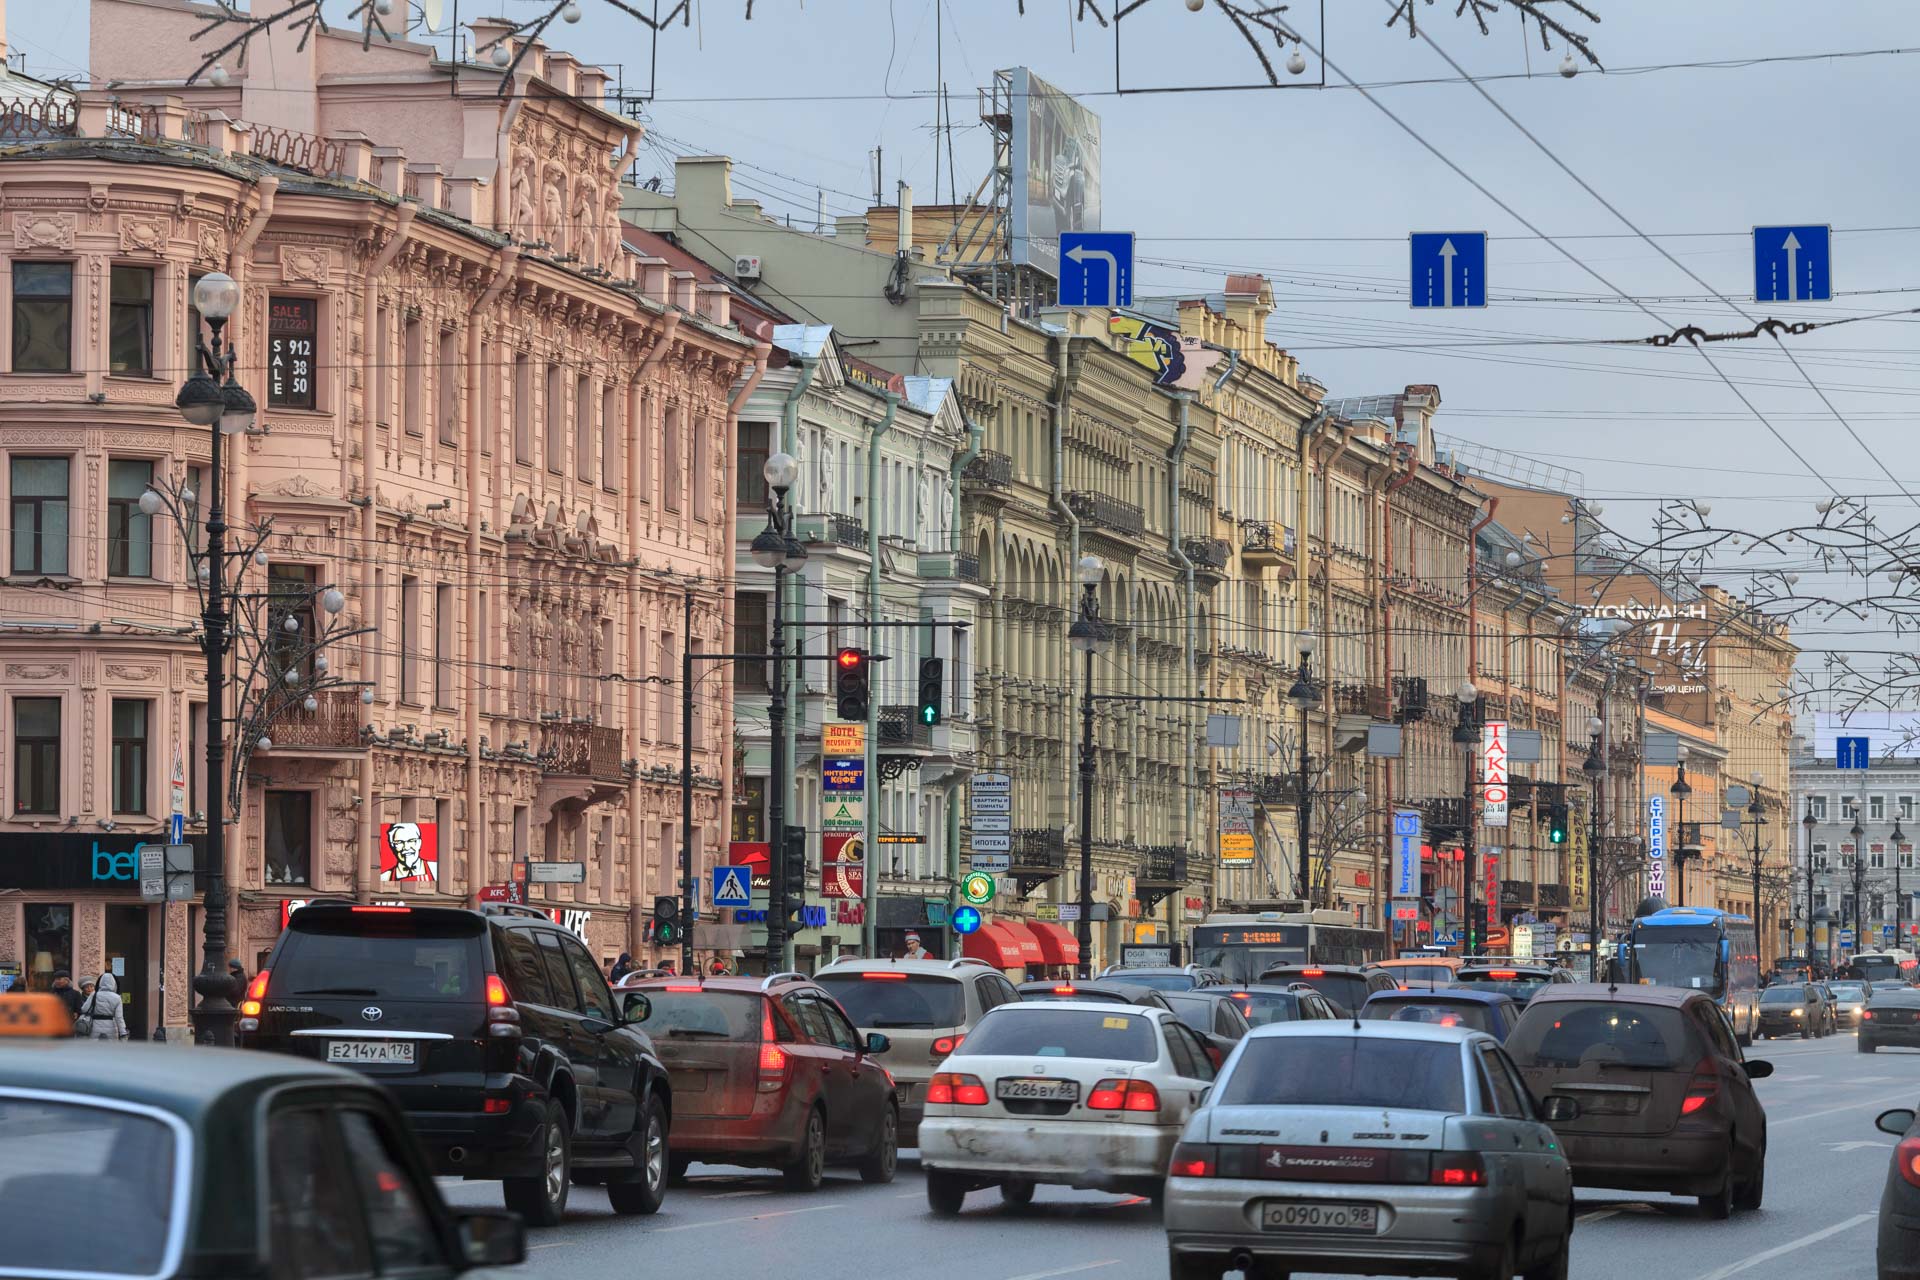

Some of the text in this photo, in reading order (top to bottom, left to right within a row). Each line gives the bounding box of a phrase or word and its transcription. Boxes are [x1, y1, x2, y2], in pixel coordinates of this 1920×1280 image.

[273, 306, 301, 317] SALE
[289, 339, 310, 355] 912
[273, 340, 283, 395] SALE
[293, 360, 307, 375] 38
[293, 378, 307, 393] 50
[831, 727, 856, 737] HOTEL
[1652, 798, 1662, 857] СТЕРЕО
[564, 909, 591, 946] KFC
[333, 1043, 411, 1058] Е214УА 178
[1271, 1207, 1370, 1225] О090УО 98
